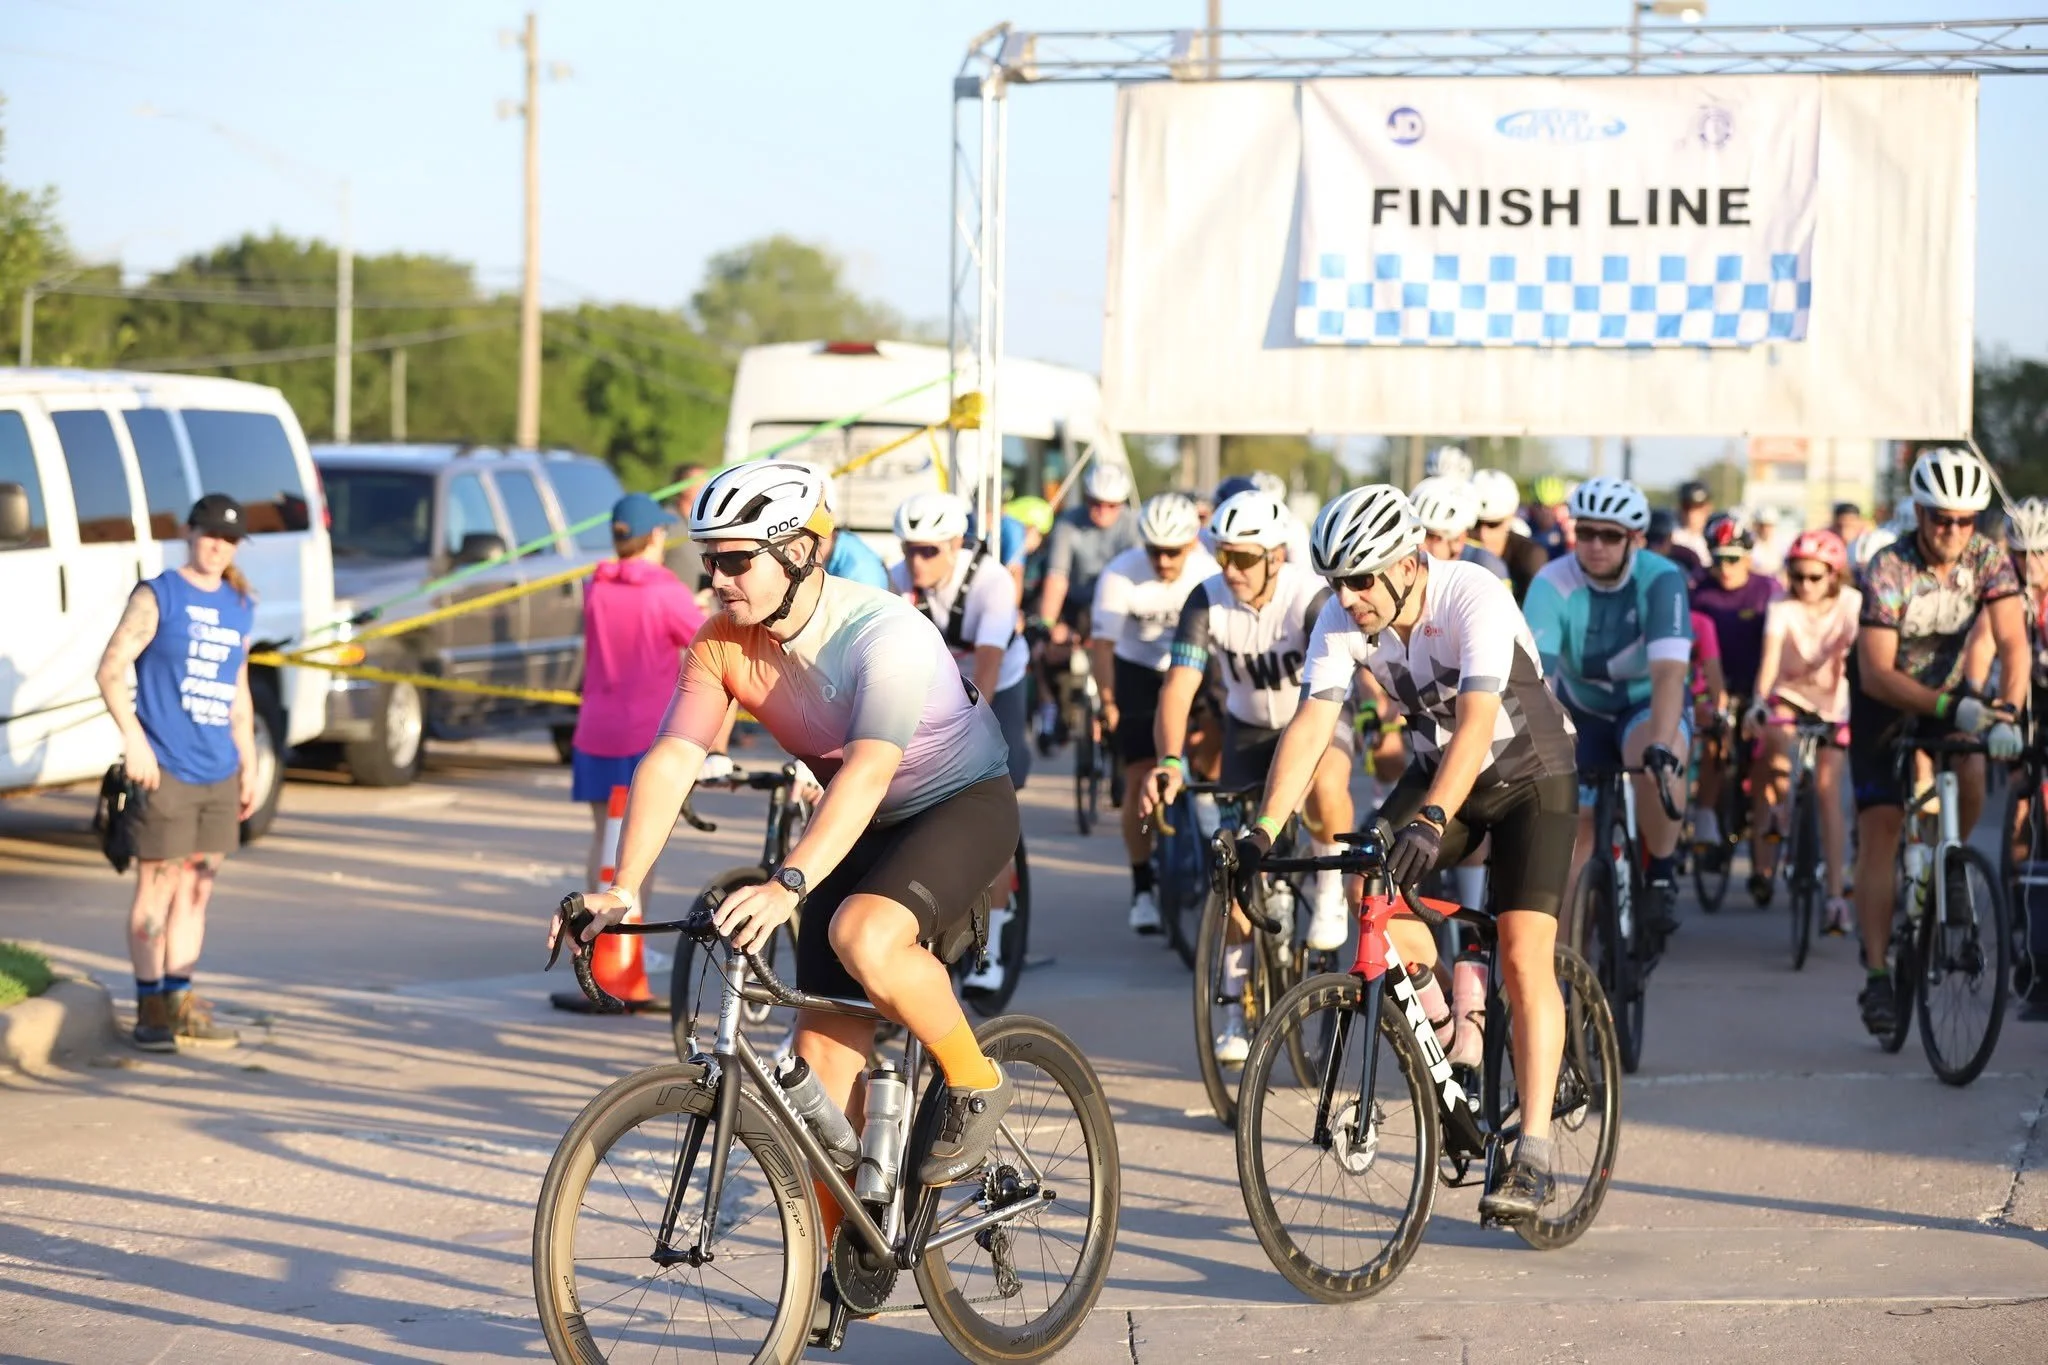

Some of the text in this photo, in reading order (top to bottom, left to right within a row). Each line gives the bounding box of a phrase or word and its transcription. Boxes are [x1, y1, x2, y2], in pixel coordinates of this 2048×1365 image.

[1372, 188, 1751, 226] FINISH LINE
[1383, 929, 1468, 1113] TREK
